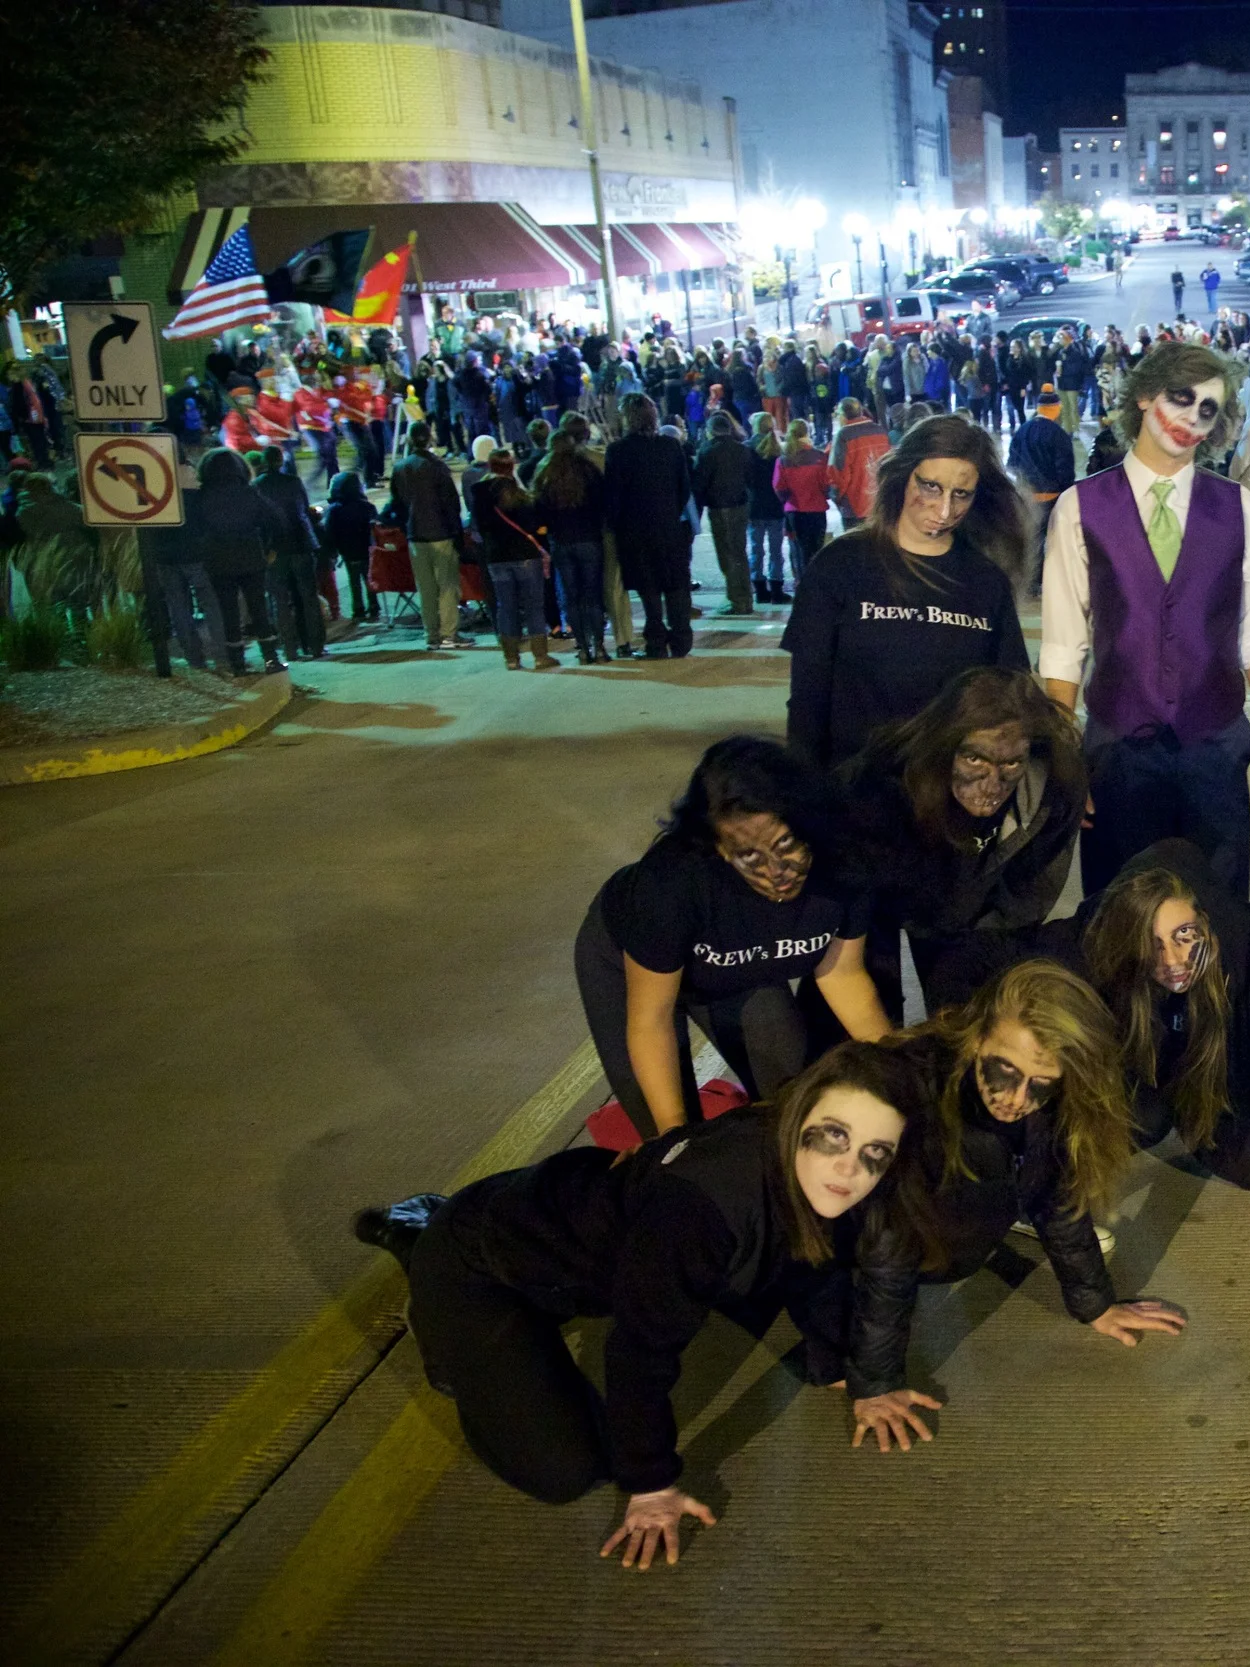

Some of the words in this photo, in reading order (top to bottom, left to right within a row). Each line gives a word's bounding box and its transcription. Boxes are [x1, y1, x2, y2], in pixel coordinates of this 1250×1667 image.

[401, 283, 417, 292] 01
[422, 280, 457, 291] West
[460, 278, 497, 289] Third
[89, 385, 147, 406] ONLY
[926, 606, 993, 631] BRIDAL
[774, 929, 838, 959] BRID
